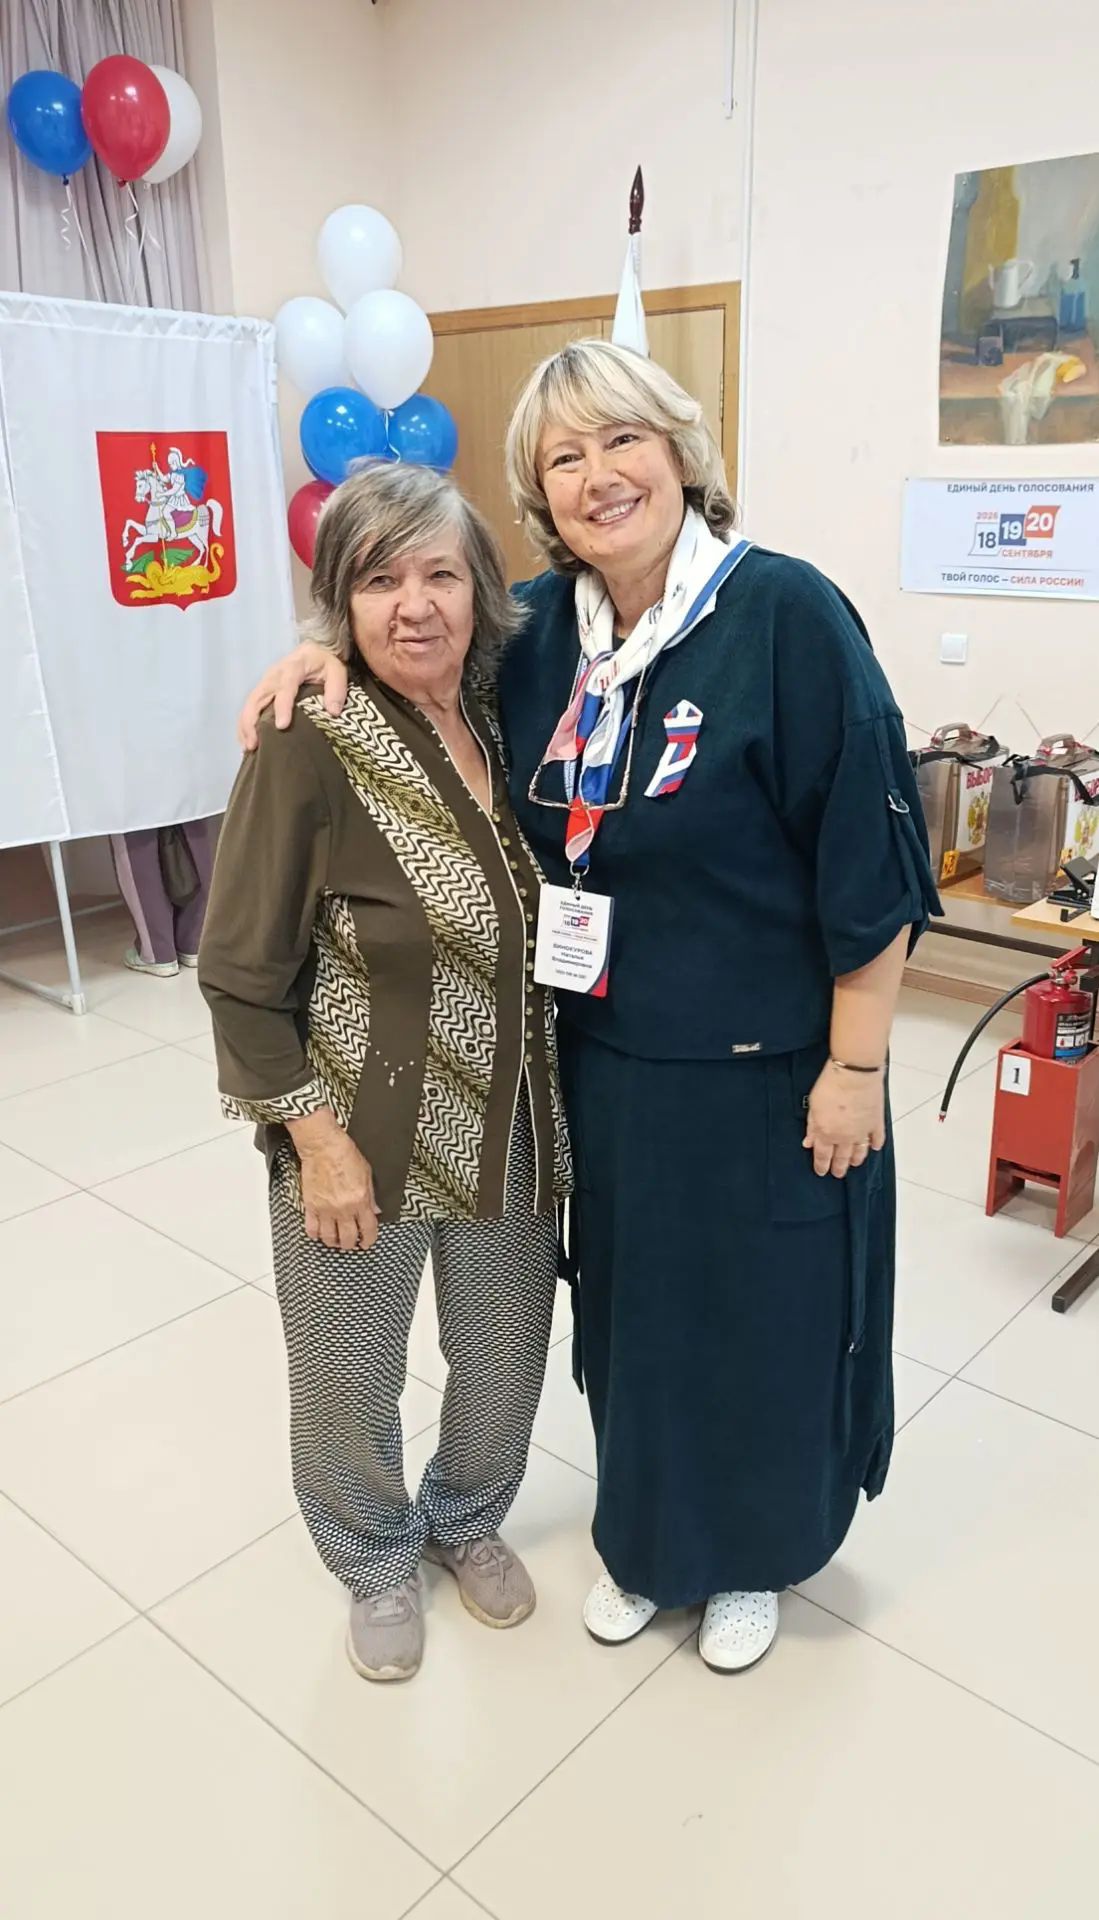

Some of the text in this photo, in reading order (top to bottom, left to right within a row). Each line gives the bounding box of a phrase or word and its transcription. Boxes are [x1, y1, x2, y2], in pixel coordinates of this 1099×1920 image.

[947, 482, 1094, 493] ЕДИНЫЙ ДЕНЬ ГОЛОСОВАНИЯ
[978, 512, 1053, 549] 18 19 20
[1002, 549, 1053, 559] СЕНТЯБРЯ
[941, 571, 966, 582] ТВОЙ
[968, 573, 999, 583] ГОЛОС
[1010, 575, 1037, 585] СИЛА
[1040, 576, 1084, 587] РОССИИ!
[967, 766, 993, 789] ВЫБОР
[1012, 1067, 1020, 1084] 1
